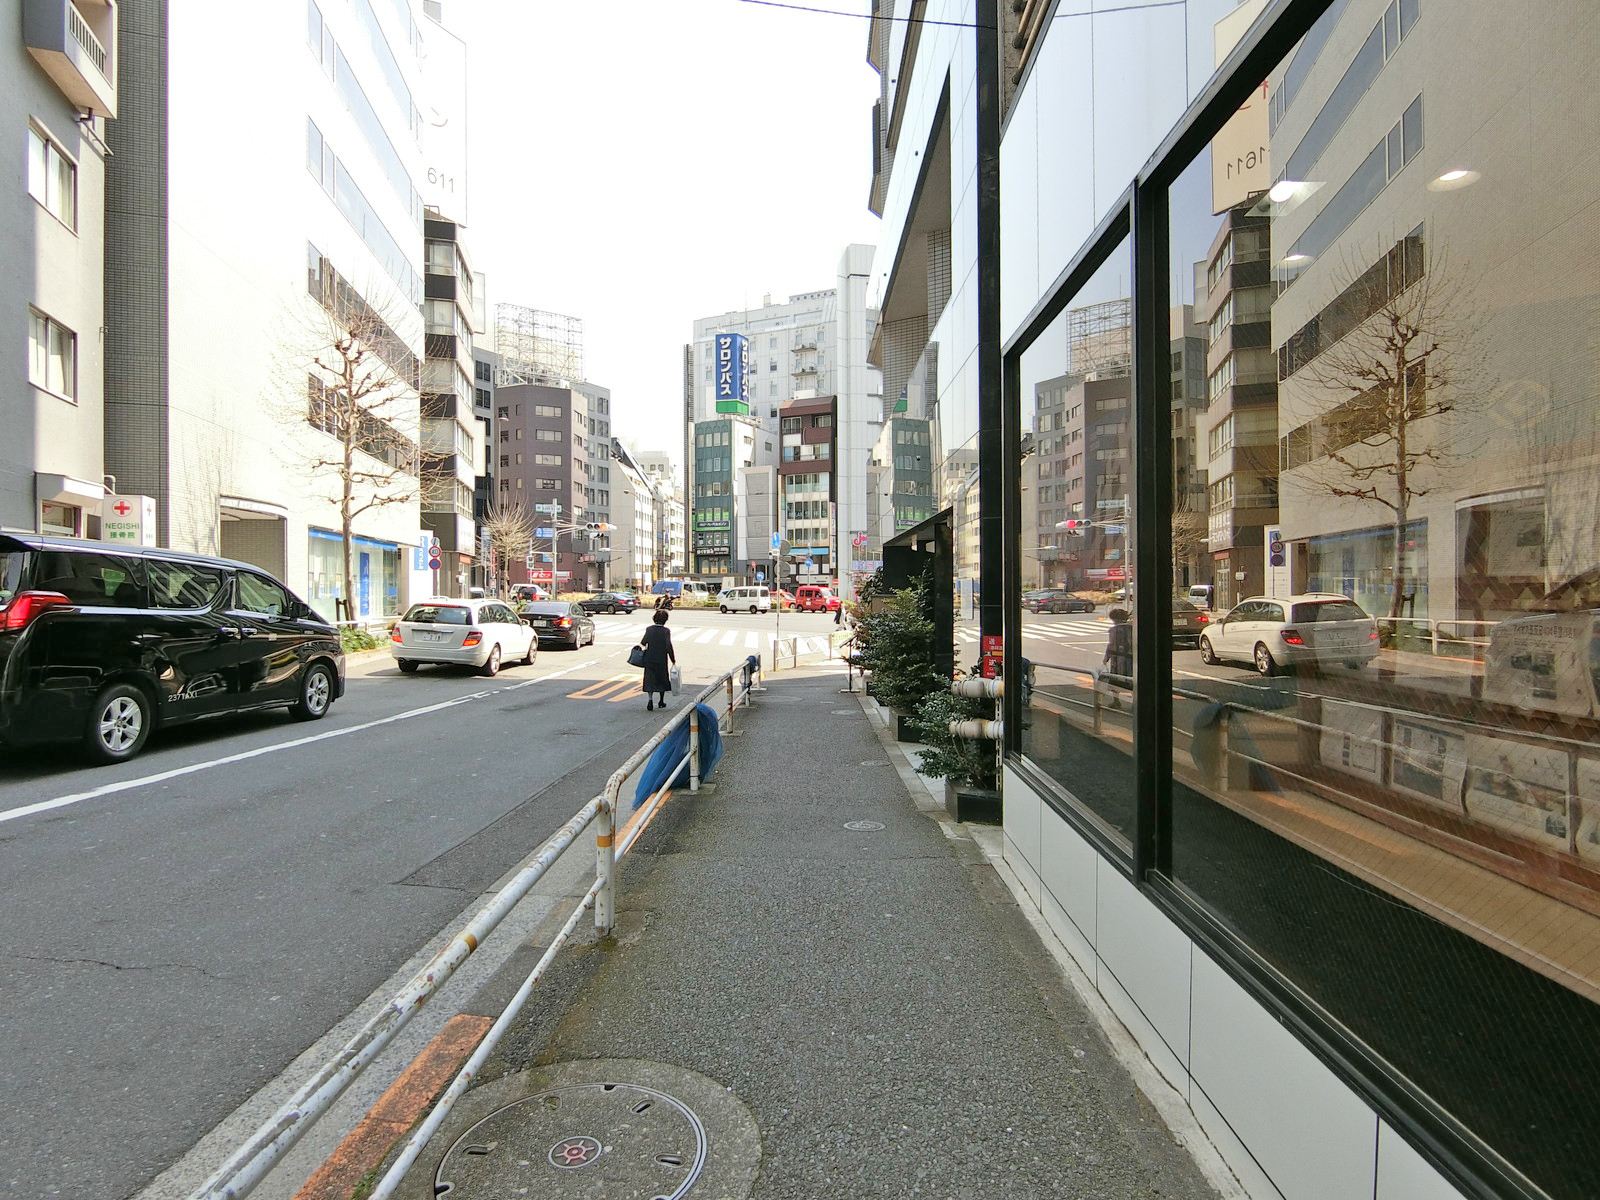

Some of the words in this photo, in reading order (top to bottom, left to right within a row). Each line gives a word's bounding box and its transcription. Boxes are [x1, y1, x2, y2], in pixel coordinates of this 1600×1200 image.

[428, 167, 454, 193] 611
[720, 336, 733, 396] サロンパス
[105, 522, 140, 530] NEGISHI
